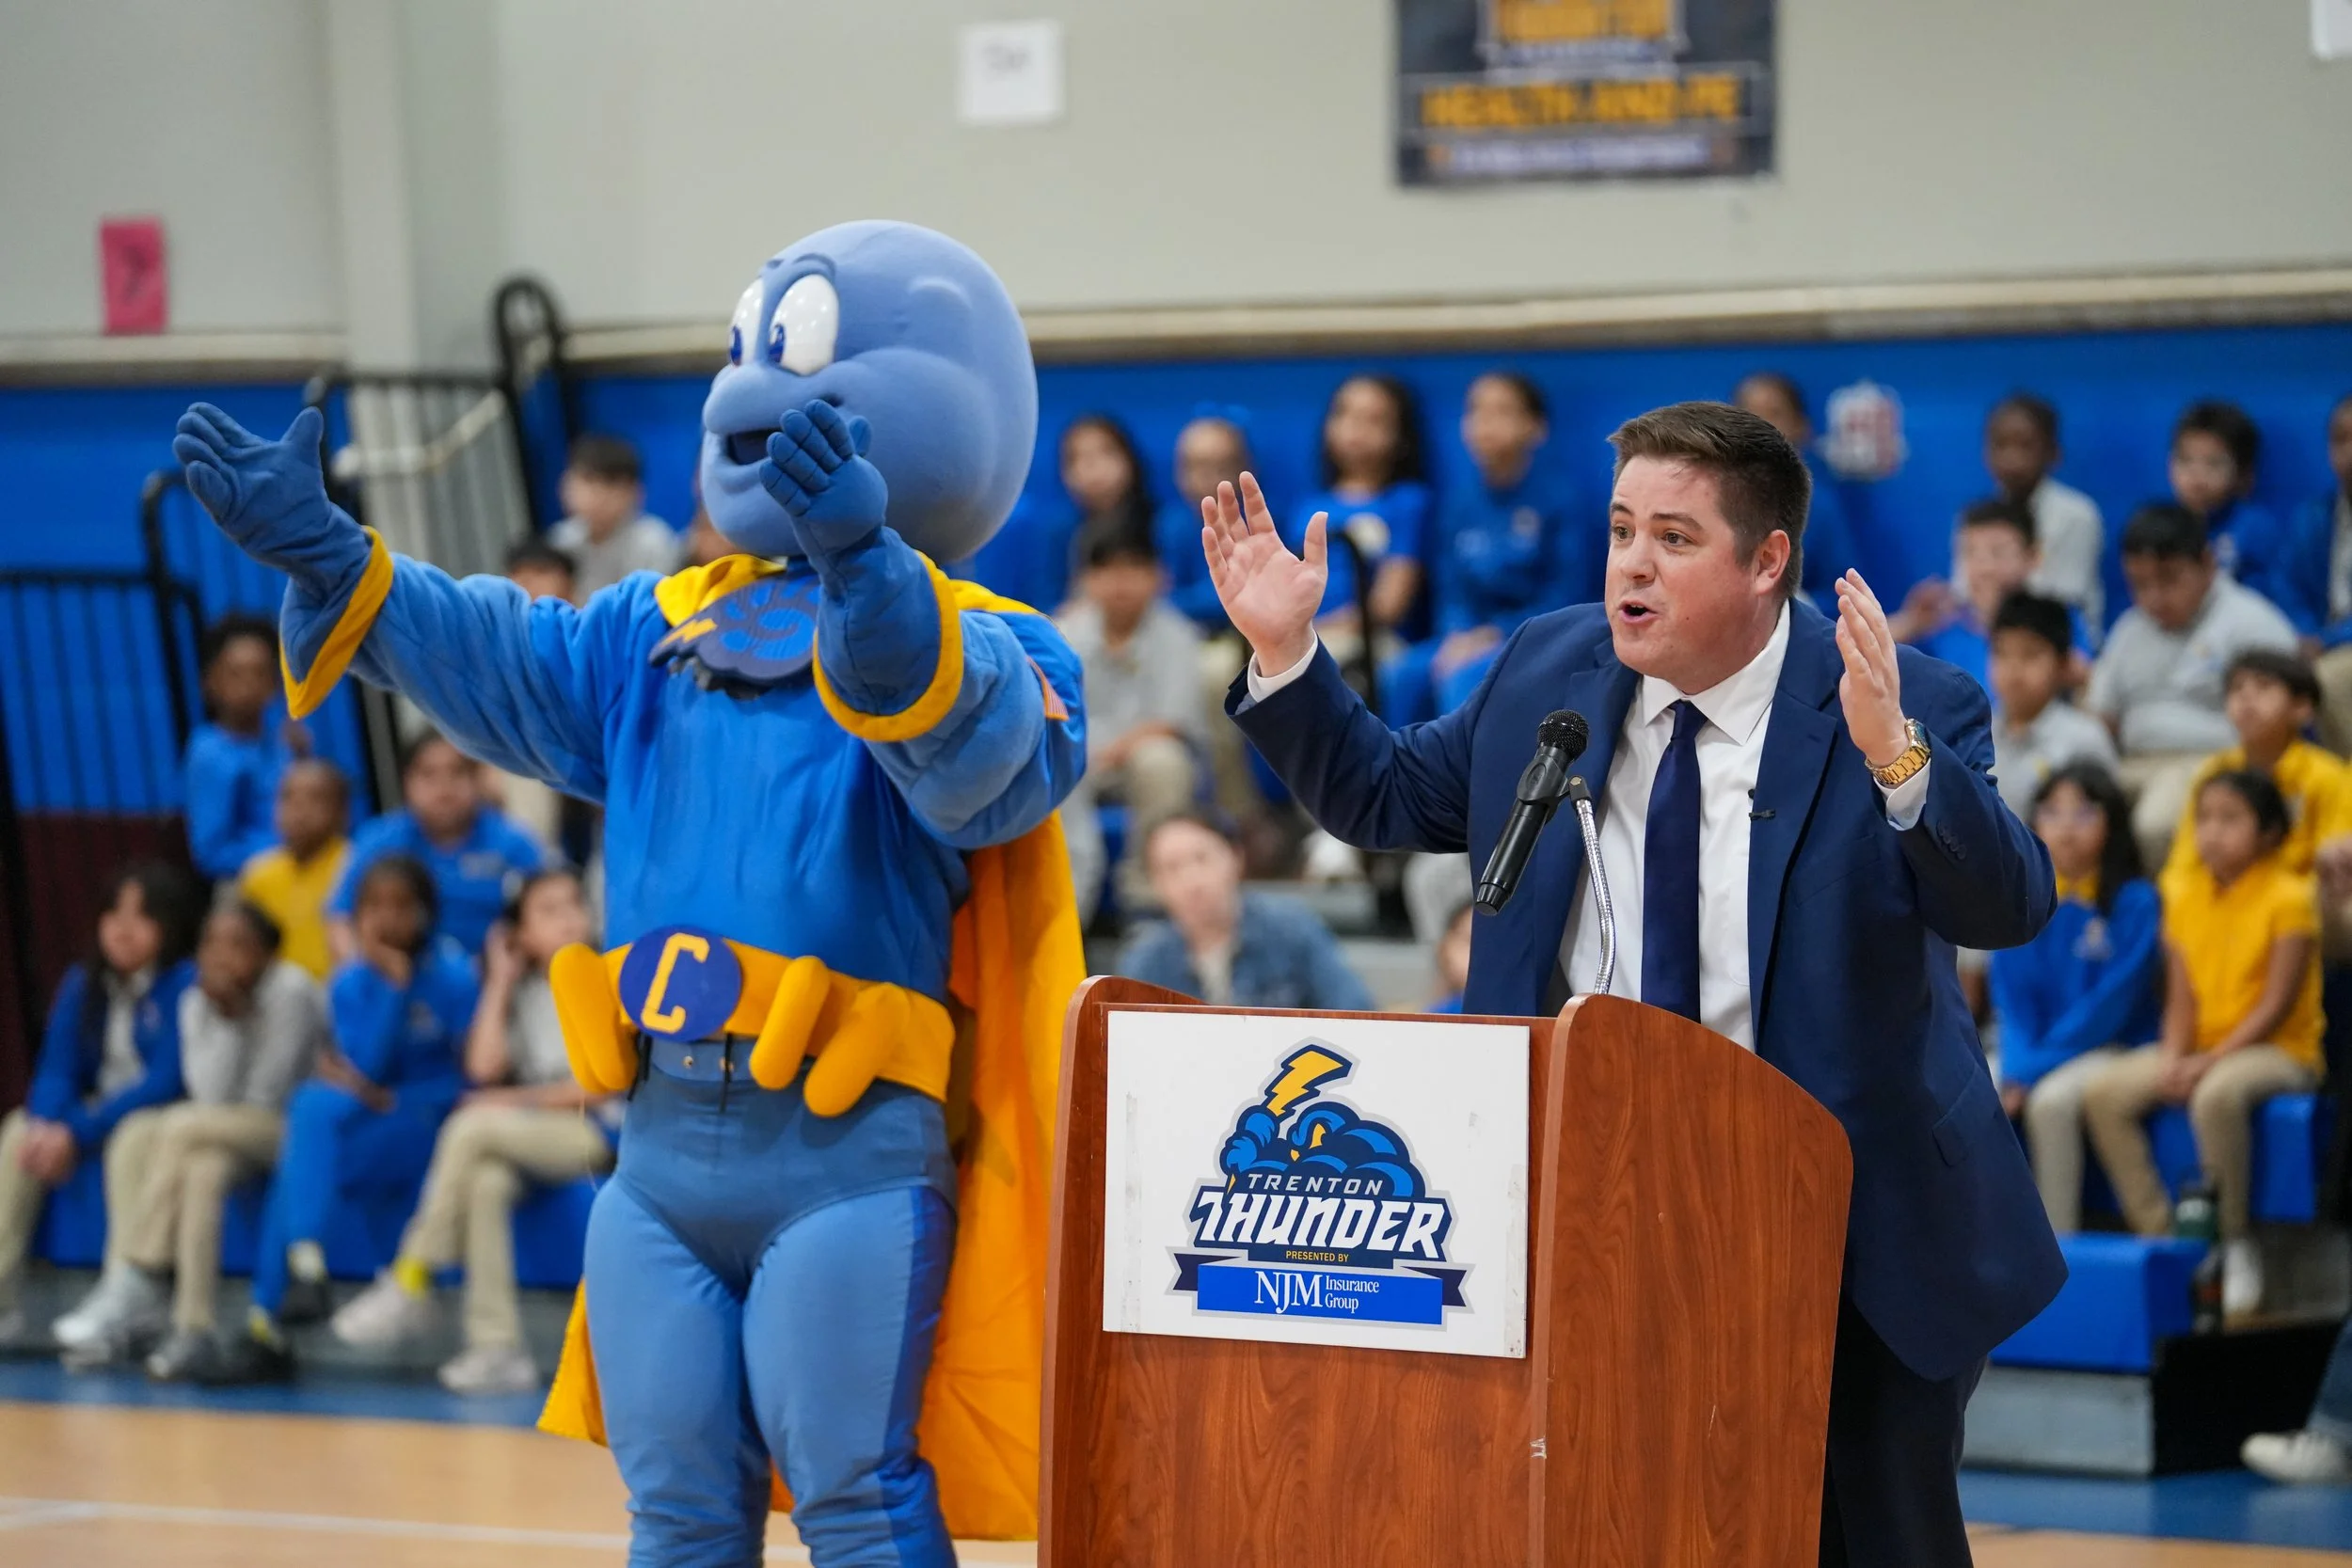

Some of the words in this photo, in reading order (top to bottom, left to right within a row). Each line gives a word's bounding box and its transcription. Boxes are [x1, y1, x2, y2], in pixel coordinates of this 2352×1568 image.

[641, 932, 710, 1034] C
[1248, 1173, 1384, 1196] TRENTON
[1196, 1190, 1445, 1259] THUNDER
[1285, 1250, 1336, 1262] PRESENTED
[1338, 1253, 1349, 1262] BY
[1254, 1270, 1324, 1314] NJM
[1326, 1275, 1380, 1293] Insurance
[1325, 1292, 1359, 1314] Group
